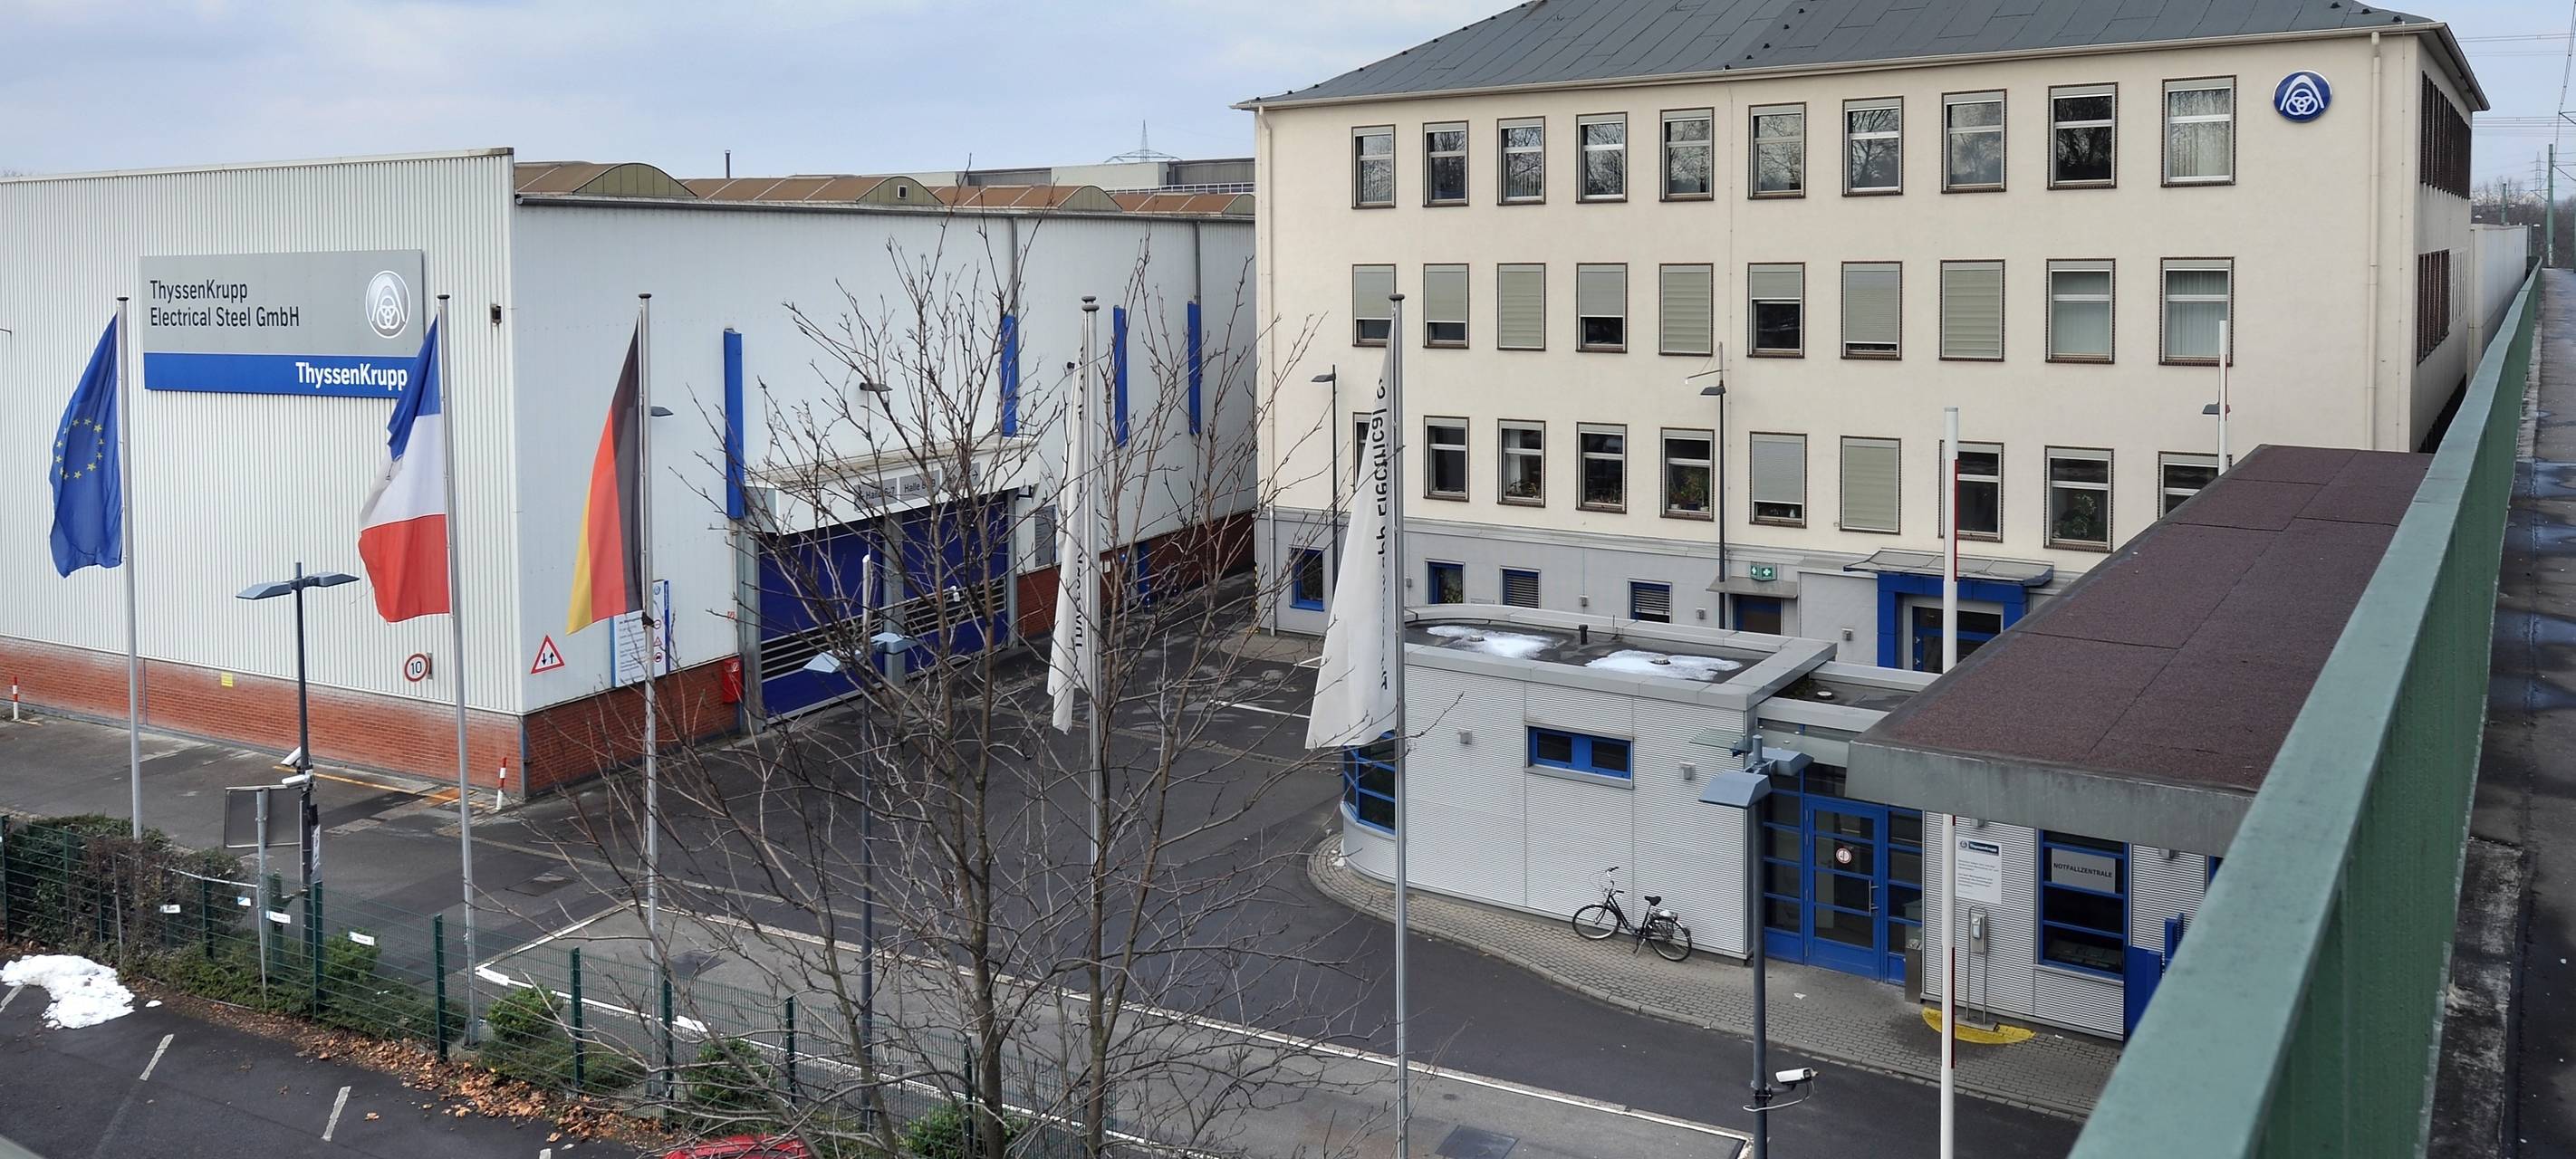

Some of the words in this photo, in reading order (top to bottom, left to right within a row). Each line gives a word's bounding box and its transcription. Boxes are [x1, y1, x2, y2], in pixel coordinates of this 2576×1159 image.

[150, 280, 247, 303] ThyssenKrupp
[150, 307, 211, 327] Electrical
[216, 306, 251, 327] Steel
[256, 306, 300, 327] GmbH
[295, 361, 408, 391] ThyssenKrupp
[410, 661, 423, 675] 10
[2053, 863, 2113, 878] NOTFALLZENTRALE
